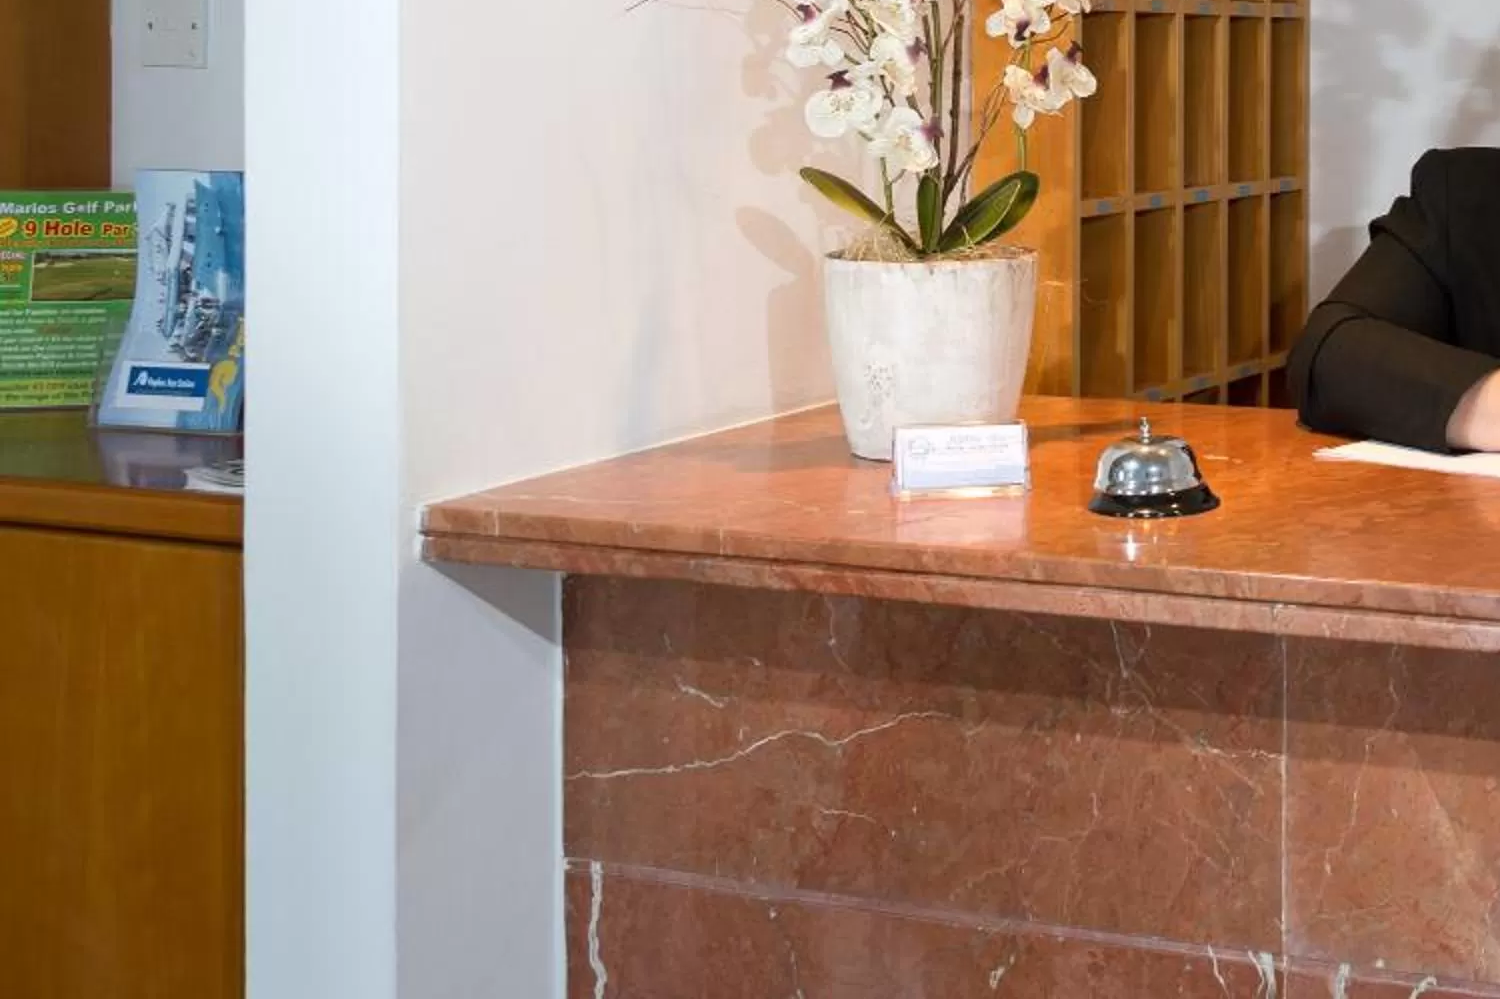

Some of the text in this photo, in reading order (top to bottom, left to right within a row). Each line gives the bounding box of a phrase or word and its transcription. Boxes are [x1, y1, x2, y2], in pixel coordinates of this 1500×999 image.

[63, 200, 99, 215] Golf
[23, 219, 38, 237] 9
[43, 219, 94, 237] Hole
[101, 222, 130, 237] Par
